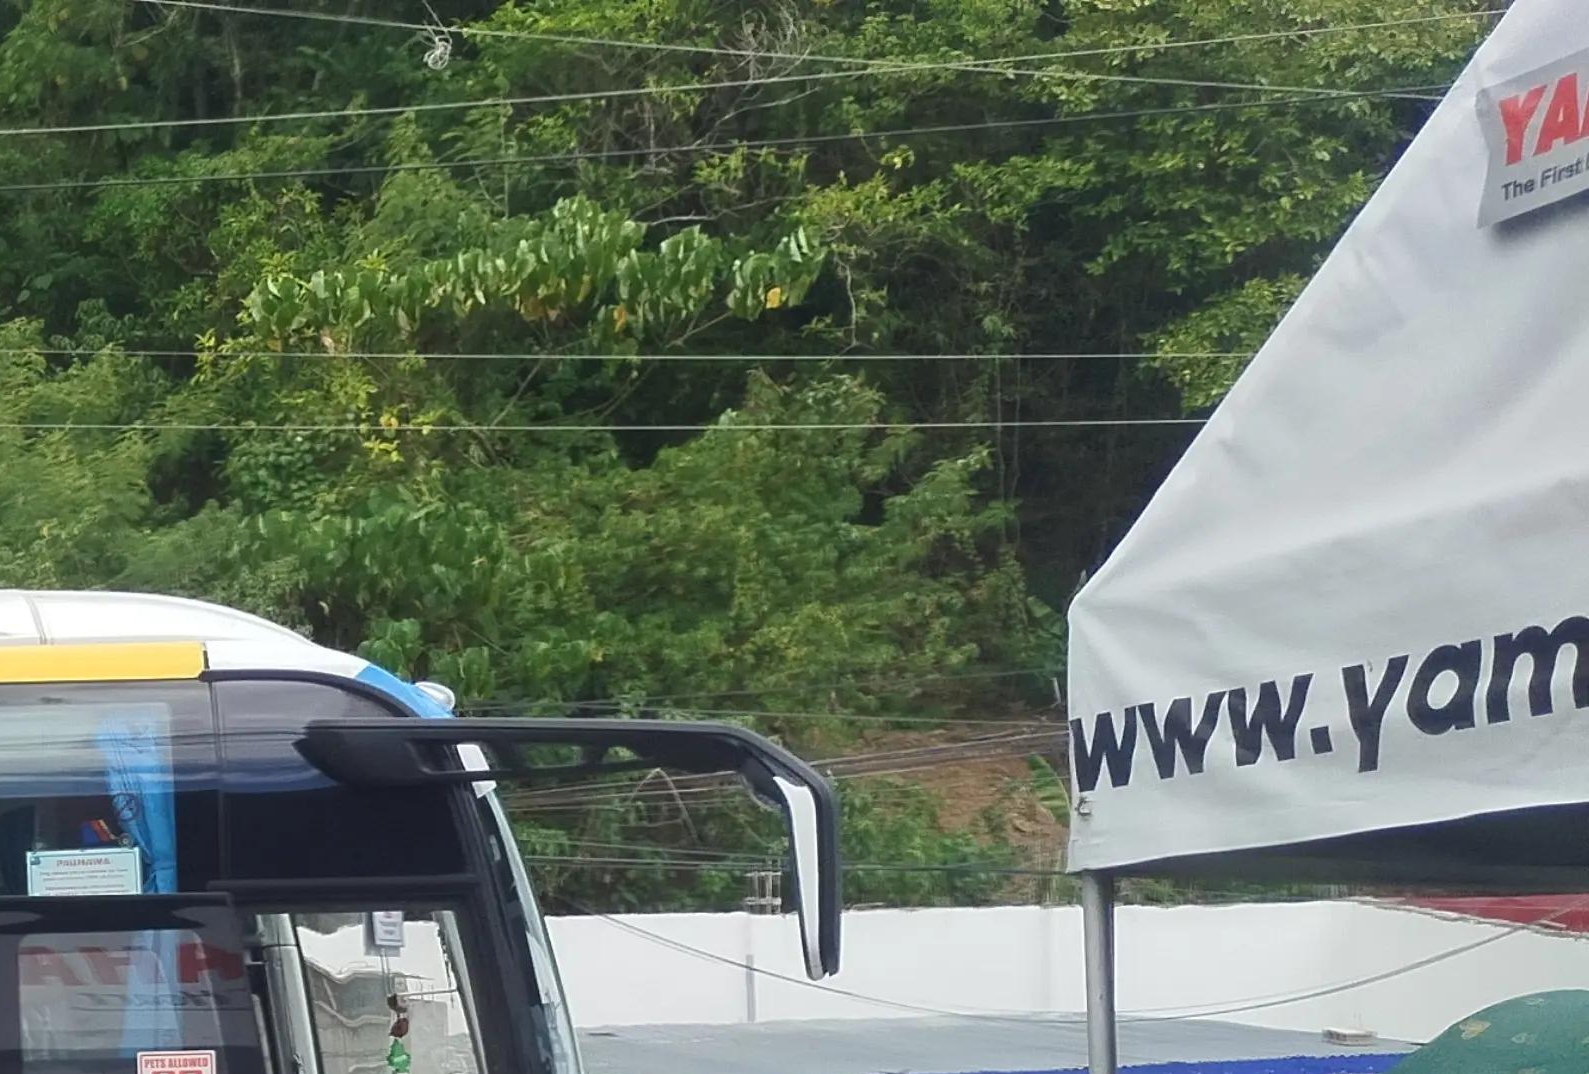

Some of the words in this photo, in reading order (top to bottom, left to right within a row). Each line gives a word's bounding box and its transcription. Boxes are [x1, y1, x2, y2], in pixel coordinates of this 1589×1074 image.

[1499, 72, 1589, 166] YA
[1501, 177, 1535, 201] The
[1540, 158, 1583, 188] First
[1070, 615, 1589, 793] www.yam
[167, 1057, 209, 1068] ALLOWED
